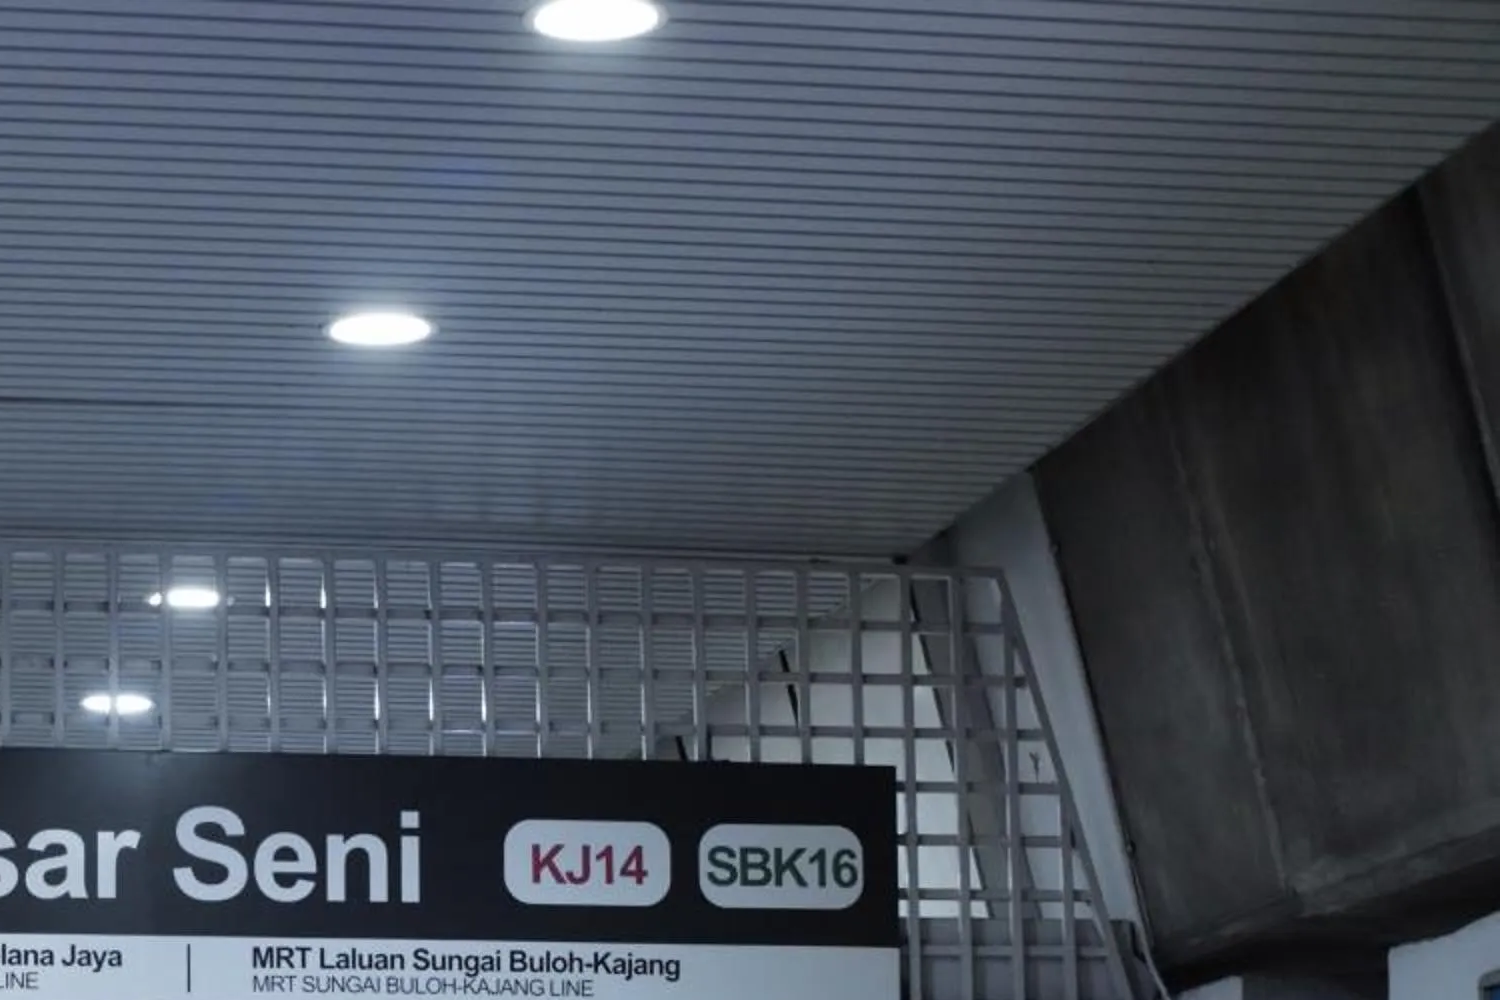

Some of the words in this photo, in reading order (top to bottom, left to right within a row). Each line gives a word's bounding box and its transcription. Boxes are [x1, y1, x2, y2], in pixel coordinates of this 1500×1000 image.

[172, 804, 421, 904] Seni
[530, 842, 650, 887] KJ14
[705, 846, 859, 890] SBK16
[61, 944, 124, 973] Jaya
[252, 946, 313, 971] MRT
[318, 946, 406, 972] Laluan
[412, 948, 501, 977] Sungai
[509, 950, 682, 983] Buloh-Kajang
[252, 975, 298, 994] MRT
[302, 976, 381, 995] SUNGAI
[387, 976, 546, 998] BULOH-KAJANG
[549, 979, 595, 998] LINE
